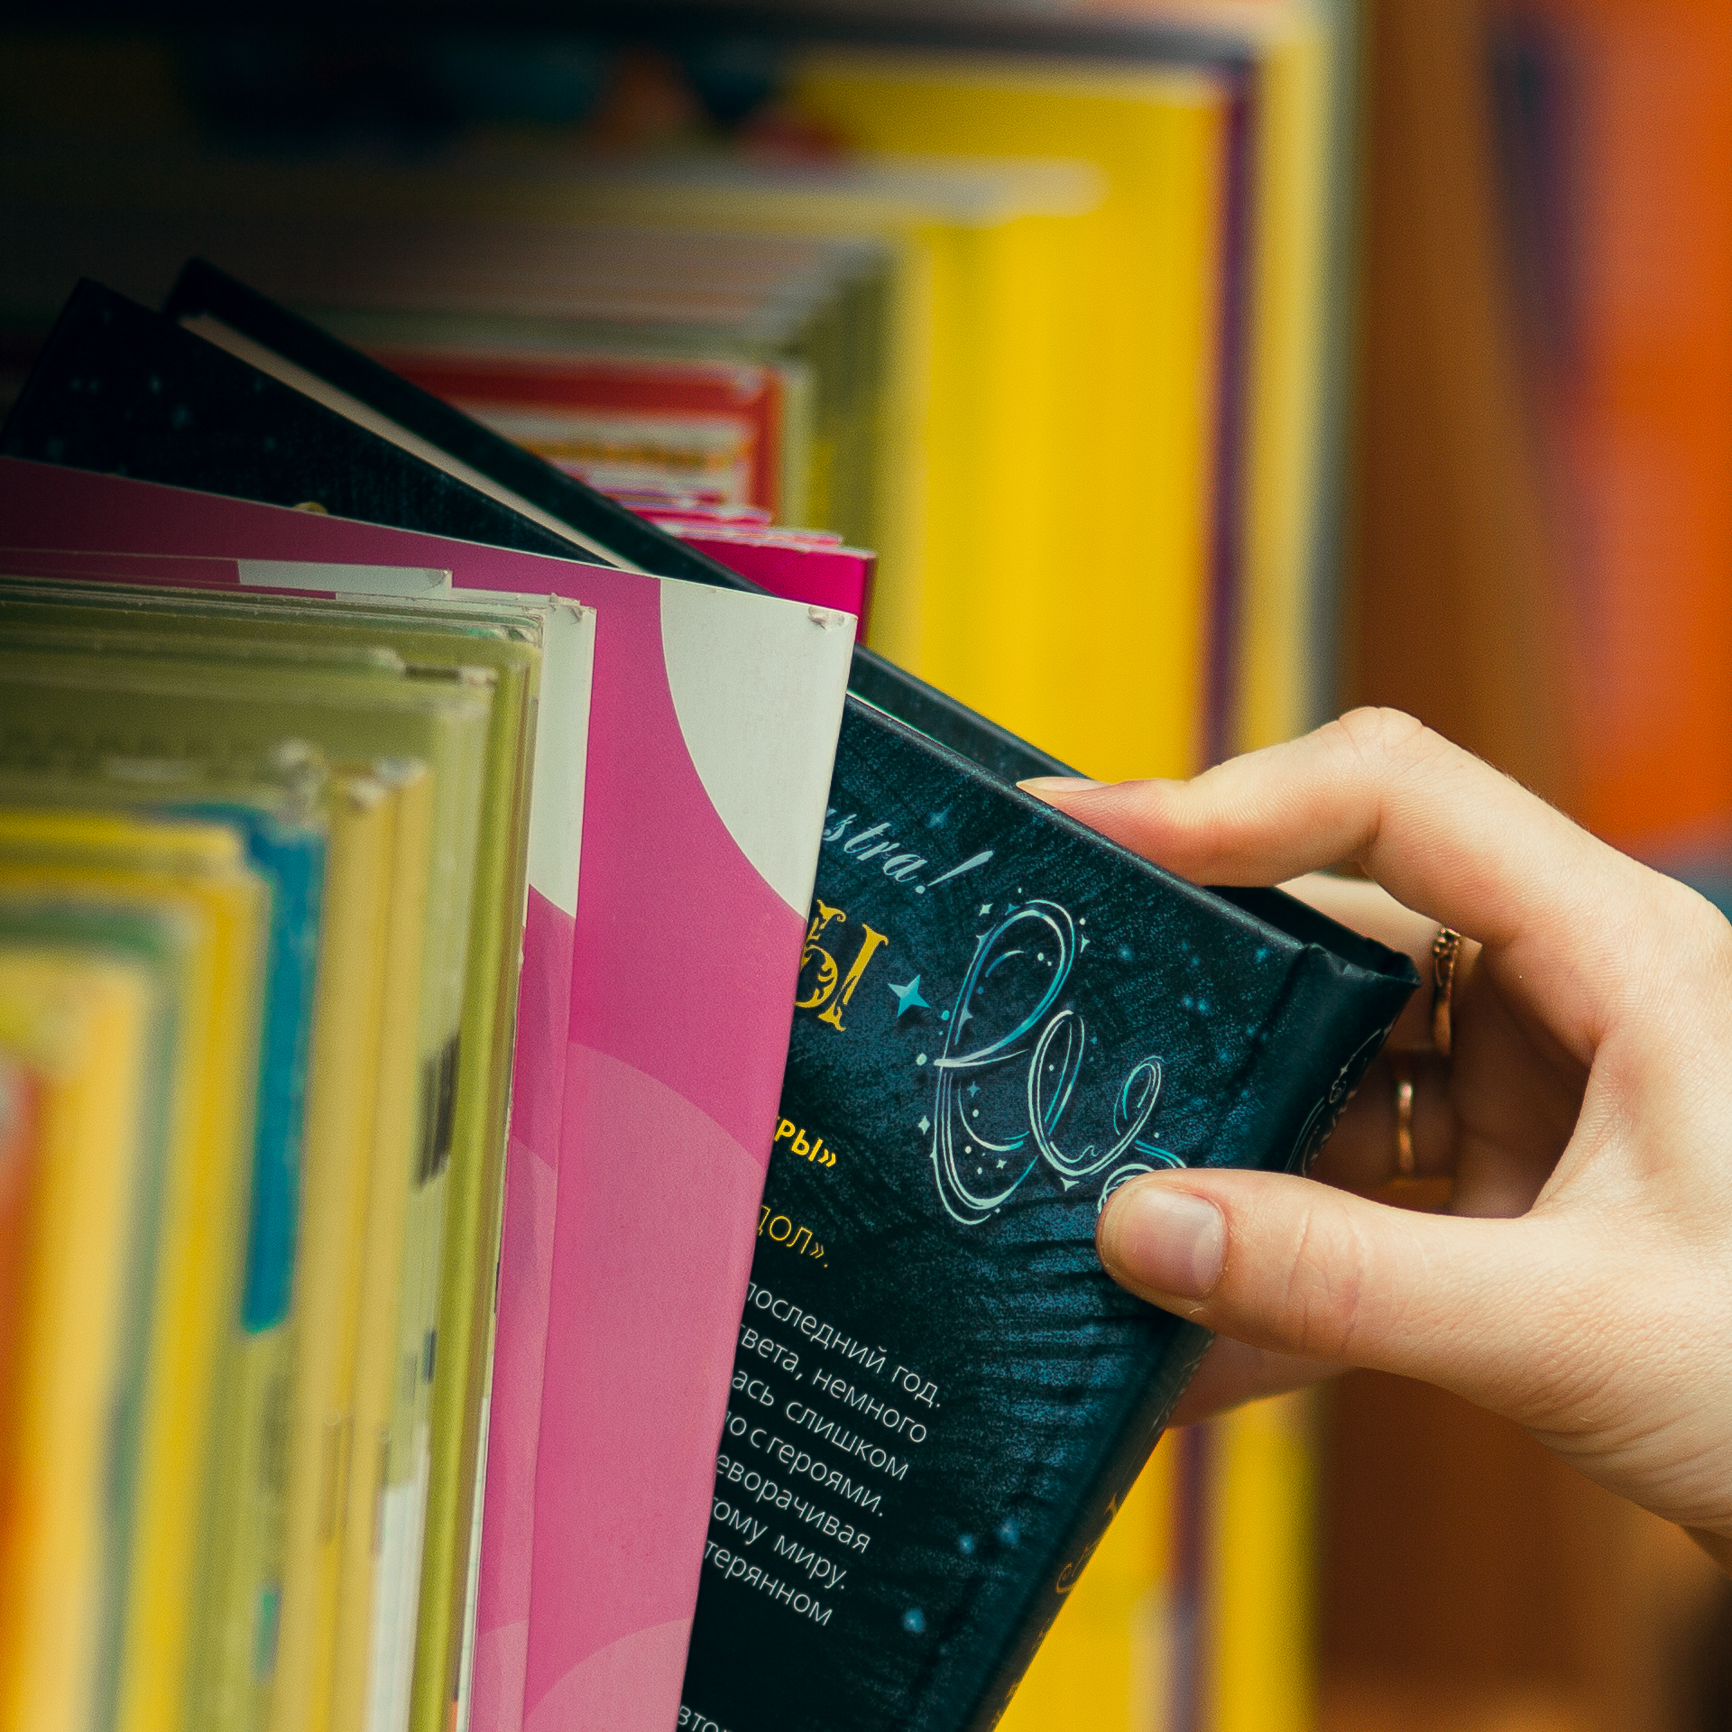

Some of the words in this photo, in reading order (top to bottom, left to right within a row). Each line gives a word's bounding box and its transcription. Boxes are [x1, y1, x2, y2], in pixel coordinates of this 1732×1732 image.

[731, 1370, 775, 1407] ась
[786, 1401, 909, 1482] слишком
[812, 1367, 928, 1443] немного
[891, 1365, 942, 1408] год.
[716, 1454, 871, 1554] еворачивая
[750, 1428, 768, 1449] с
[766, 1436, 885, 1517] героями.
[704, 1539, 833, 1627] терянном
[773, 1533, 847, 1591] миру.
